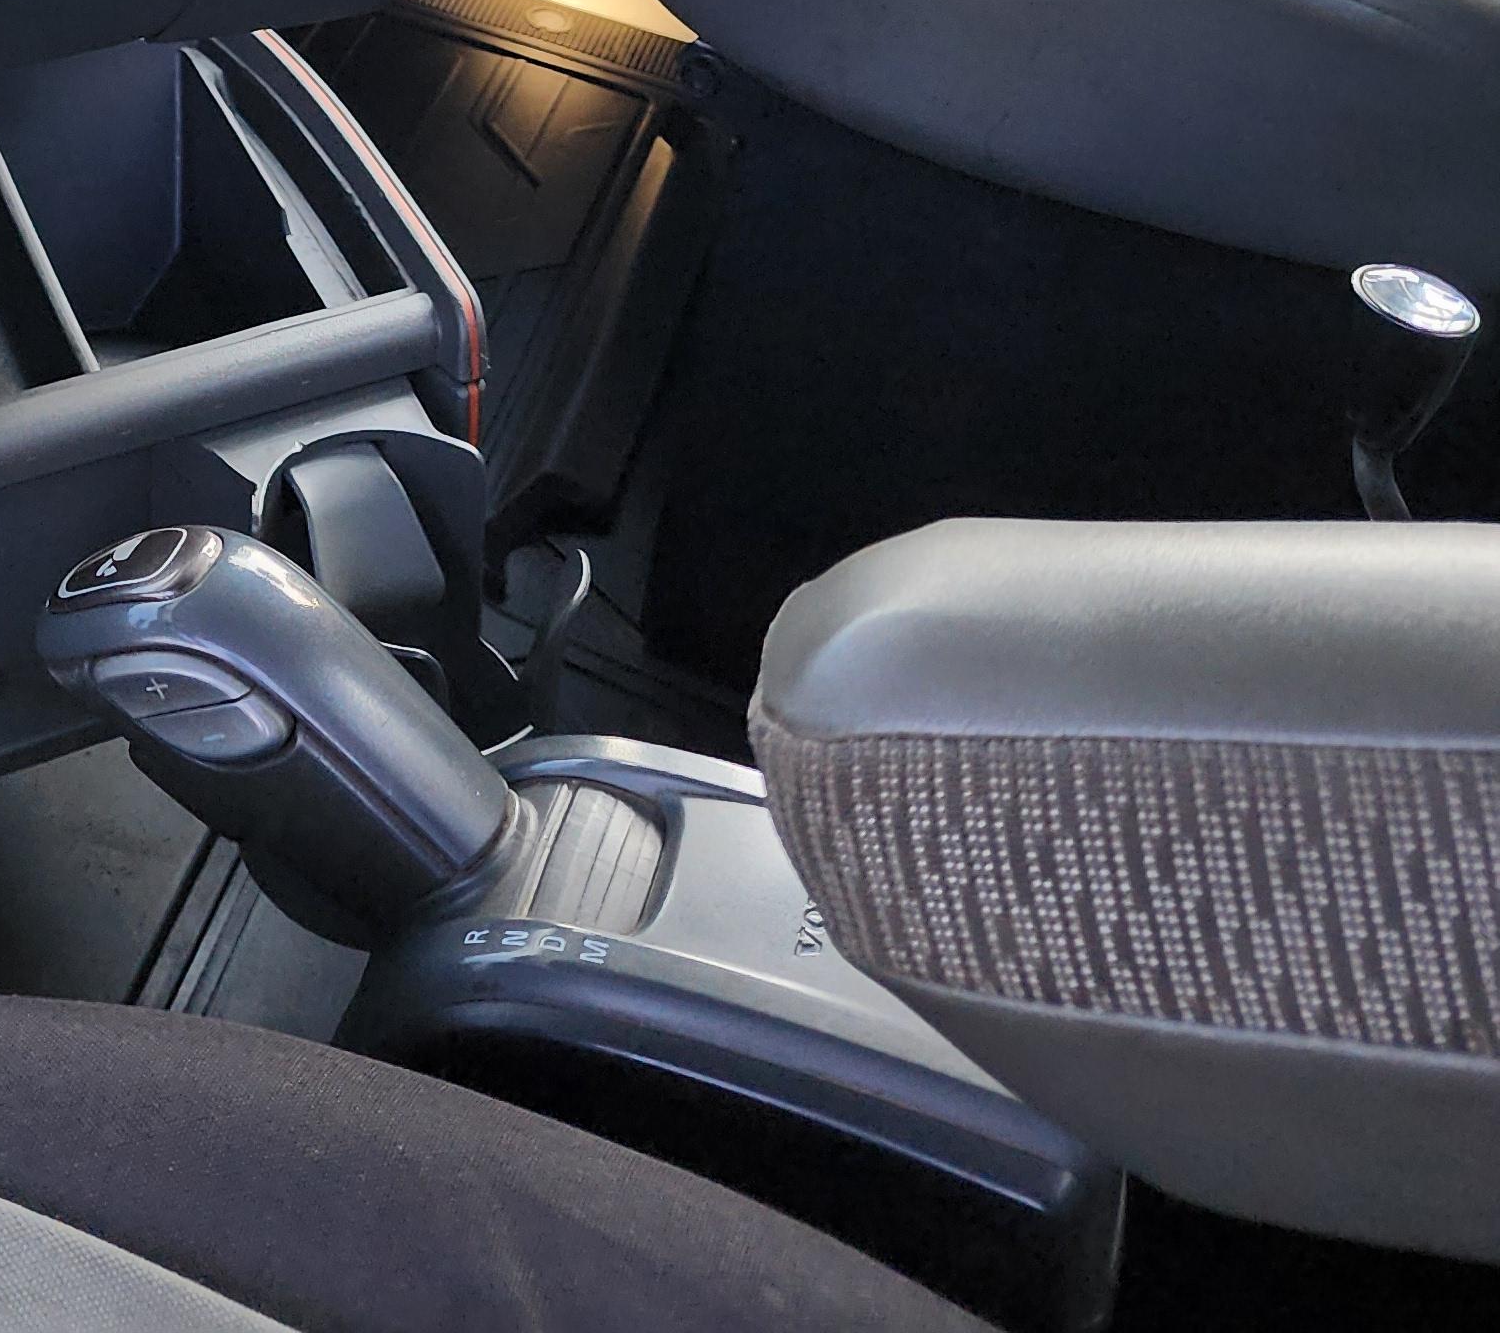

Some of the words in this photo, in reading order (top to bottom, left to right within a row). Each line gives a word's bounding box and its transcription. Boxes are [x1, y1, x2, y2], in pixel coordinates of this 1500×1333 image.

[463, 929, 490, 945] R
[501, 930, 529, 947] N
[539, 935, 567, 952] D
[579, 937, 610, 965] M
